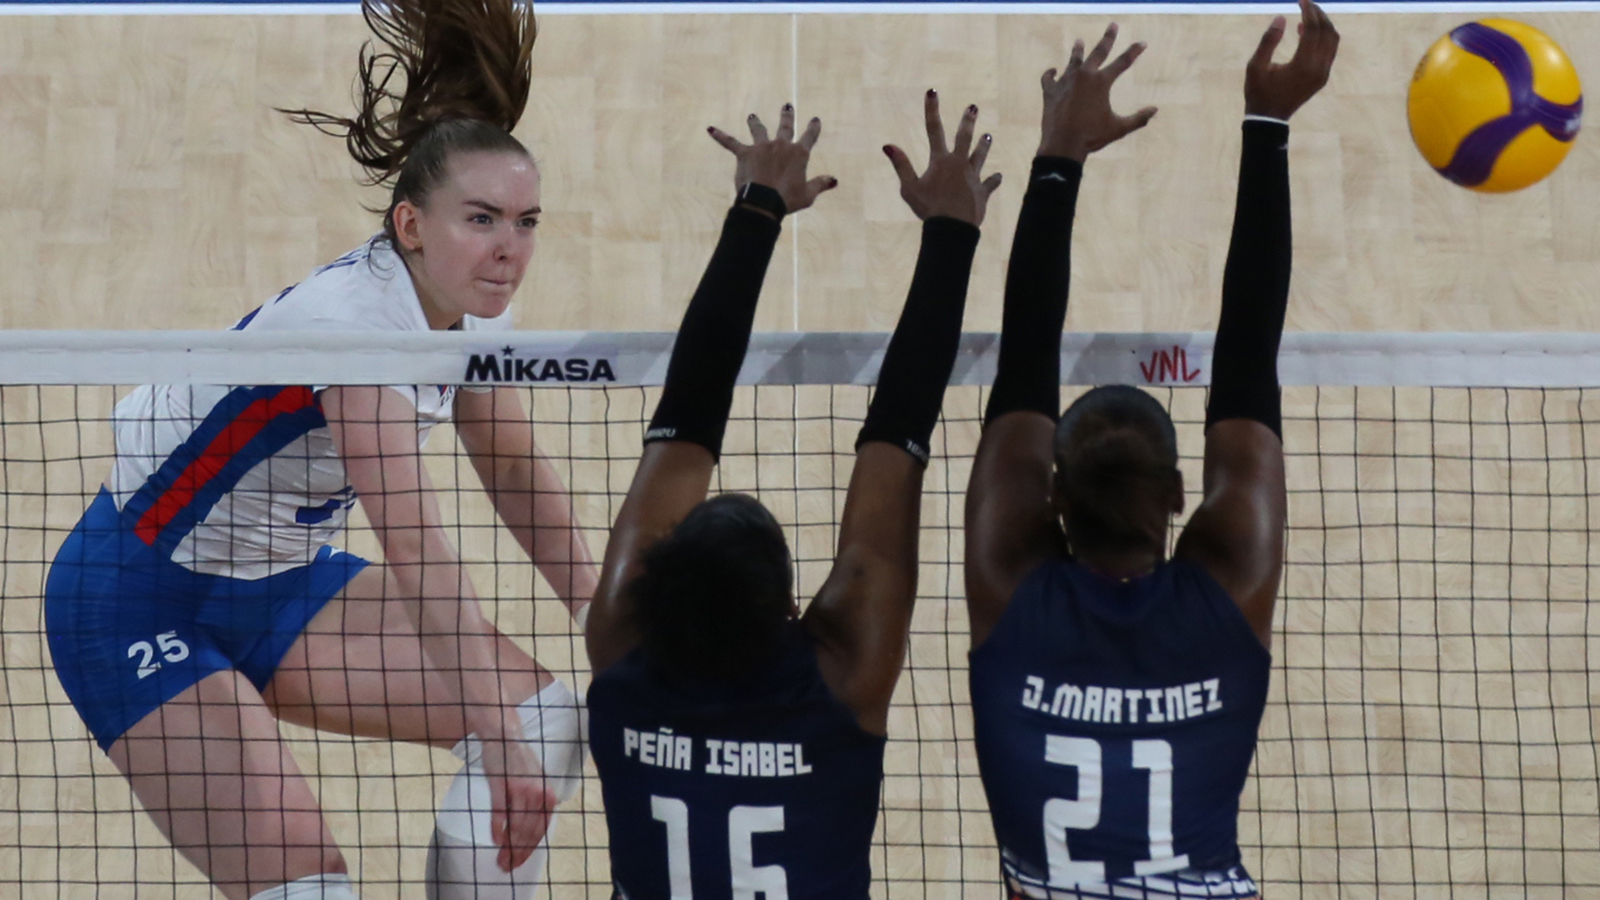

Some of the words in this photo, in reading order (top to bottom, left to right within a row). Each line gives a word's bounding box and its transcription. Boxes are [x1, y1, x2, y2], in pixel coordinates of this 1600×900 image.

[1139, 345, 1201, 383] VNL
[127, 630, 190, 680] 25
[1021, 674, 1223, 723] J.MARTINEZ
[623, 727, 692, 771] PEÑA
[705, 739, 813, 777] ISABEL
[1043, 734, 1190, 886] 21
[650, 794, 789, 900] 16
